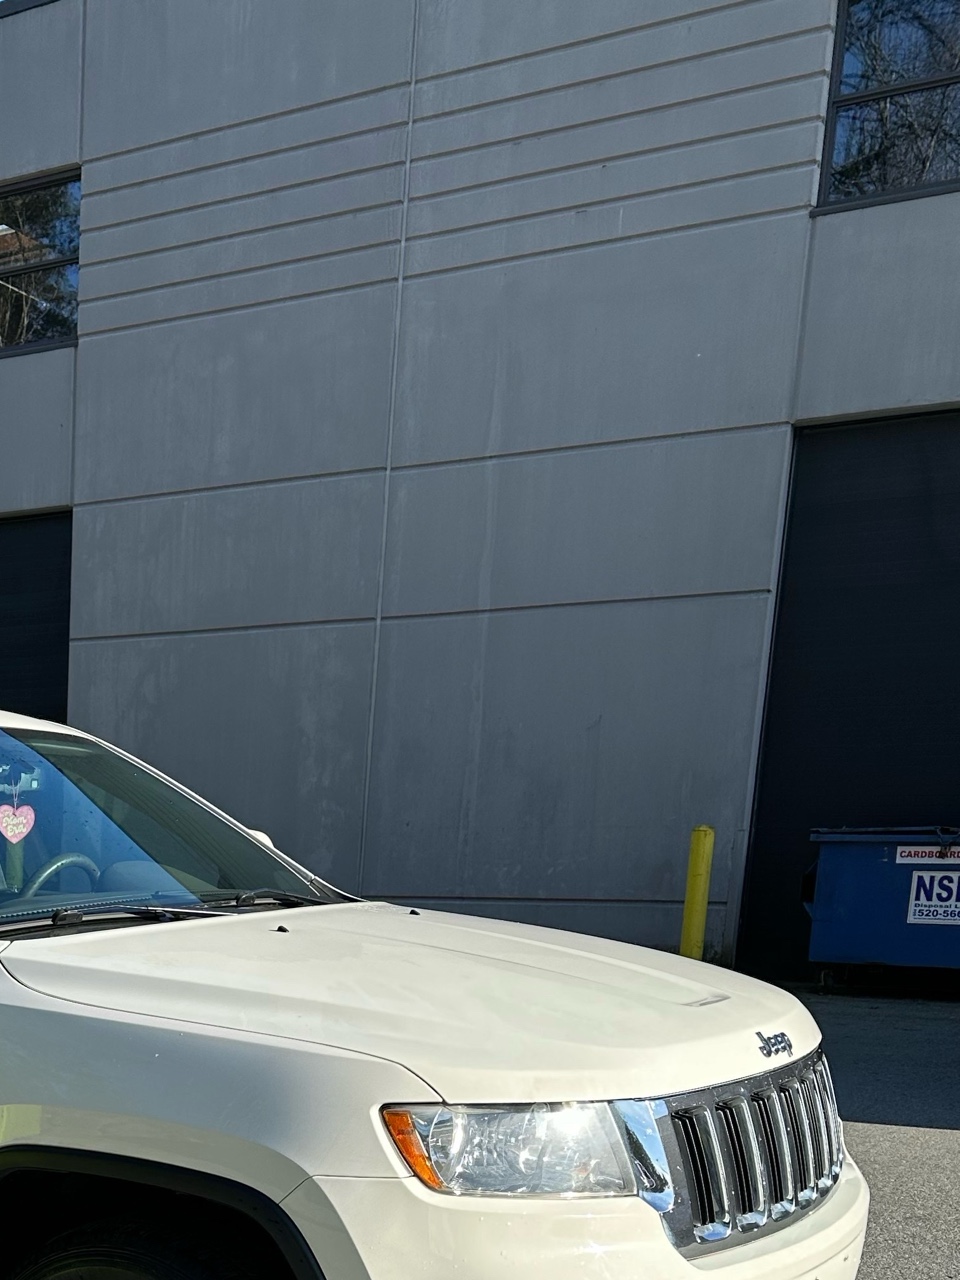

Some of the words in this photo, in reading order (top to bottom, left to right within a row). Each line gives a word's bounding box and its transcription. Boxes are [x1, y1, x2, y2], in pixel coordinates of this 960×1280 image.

[2, 816, 27, 827] Mom
[7, 824, 27, 837] Era
[915, 875, 960, 903] NS
[755, 1031, 793, 1058] Jeep
